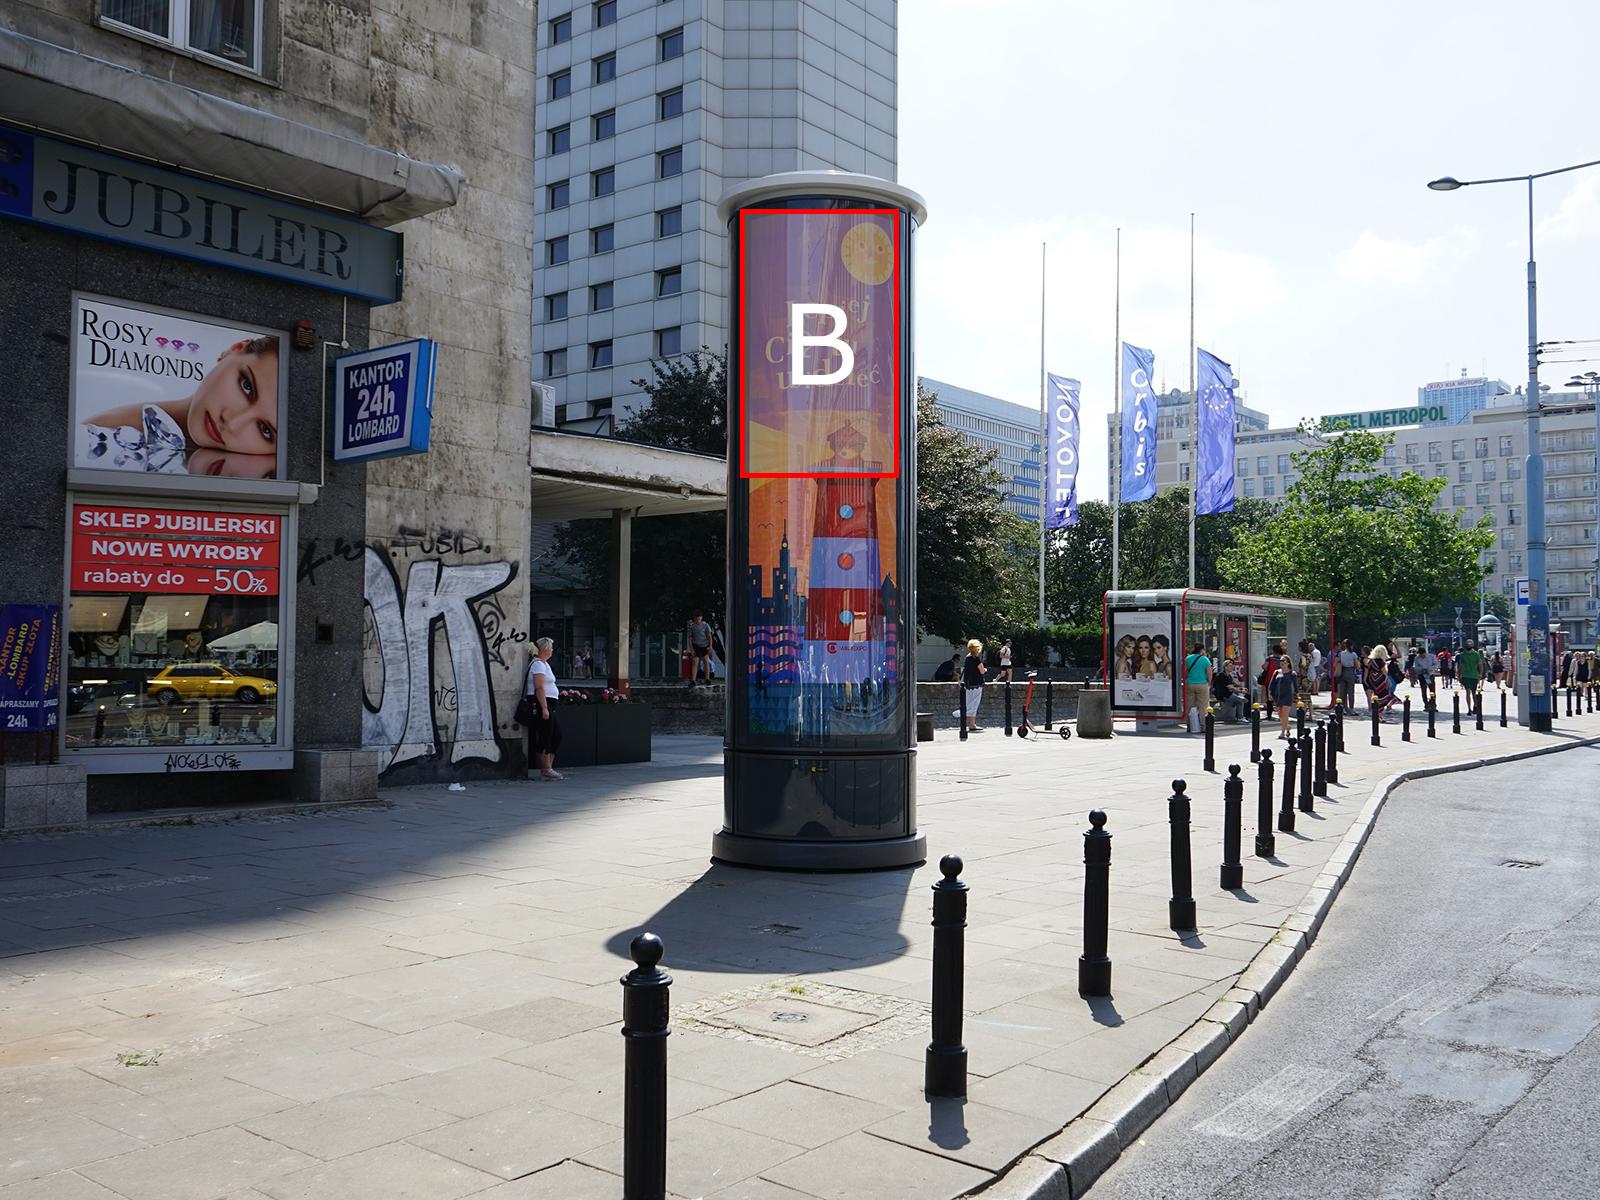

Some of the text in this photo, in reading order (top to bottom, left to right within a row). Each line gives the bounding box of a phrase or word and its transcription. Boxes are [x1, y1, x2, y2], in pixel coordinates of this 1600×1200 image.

[43, 159, 352, 280] JUBILER
[80, 308, 153, 346] ROSY
[88, 338, 204, 381] DIAMONDS
[349, 360, 404, 389] KANTOR
[356, 384, 395, 420] 24h
[1369, 405, 1447, 428] METROPOL
[348, 414, 400, 443] LOMBARD
[1130, 368, 1148, 476] Orbis
[79, 510, 275, 535] SKLEP JUBILERSKI
[91, 540, 264, 561] NOWE WYROBY
[83, 568, 153, 588] rabaty
[157, 570, 185, 585] do
[7, 714, 28, 728] 24h
